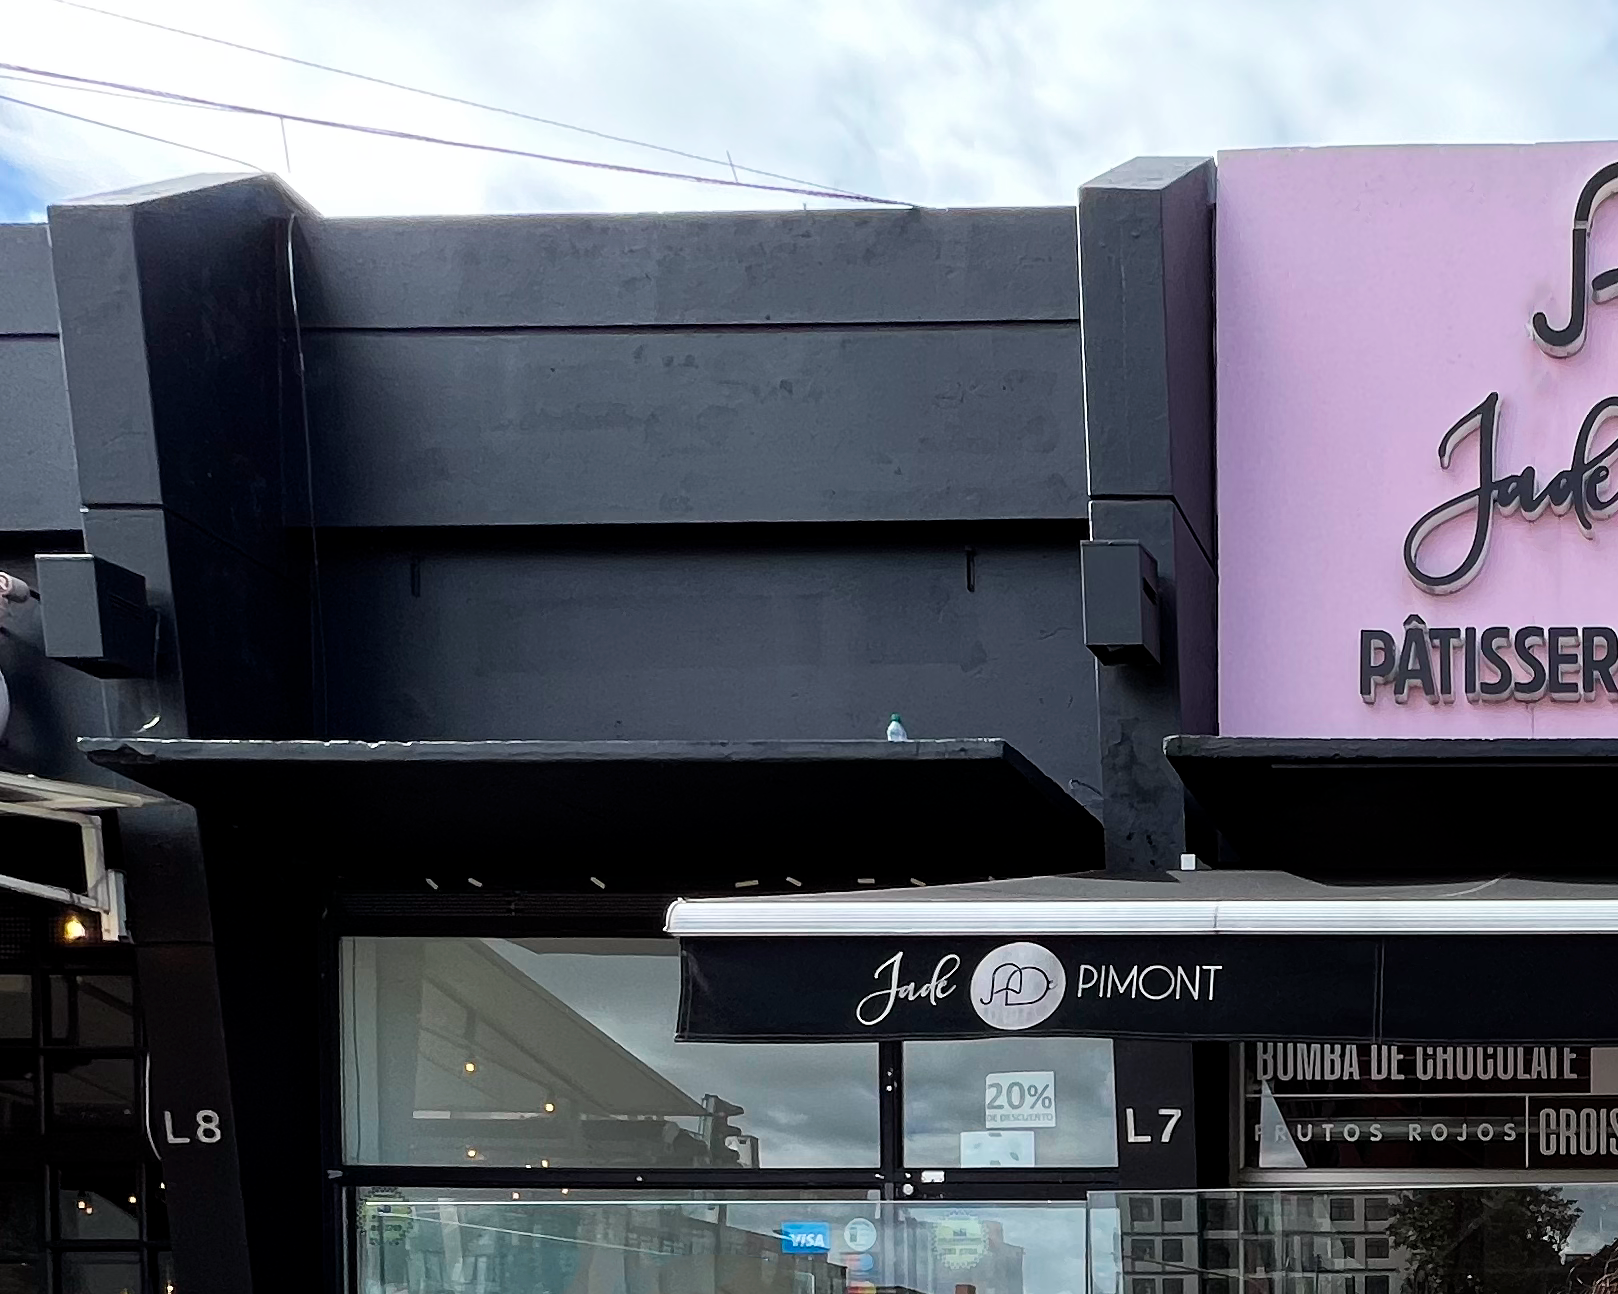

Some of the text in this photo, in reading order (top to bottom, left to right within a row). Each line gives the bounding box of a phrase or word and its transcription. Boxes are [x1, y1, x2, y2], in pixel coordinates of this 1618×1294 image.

[856, 951, 960, 1026] Jade
[1078, 964, 1222, 1001] PIMONT
[986, 1082, 1052, 1110] 20%
[164, 1110, 221, 1143] L8
[1126, 1108, 1181, 1142] L7
[1255, 1123, 1517, 1142] FRUTOS ROJOS
[790, 1233, 825, 1248] VISA
